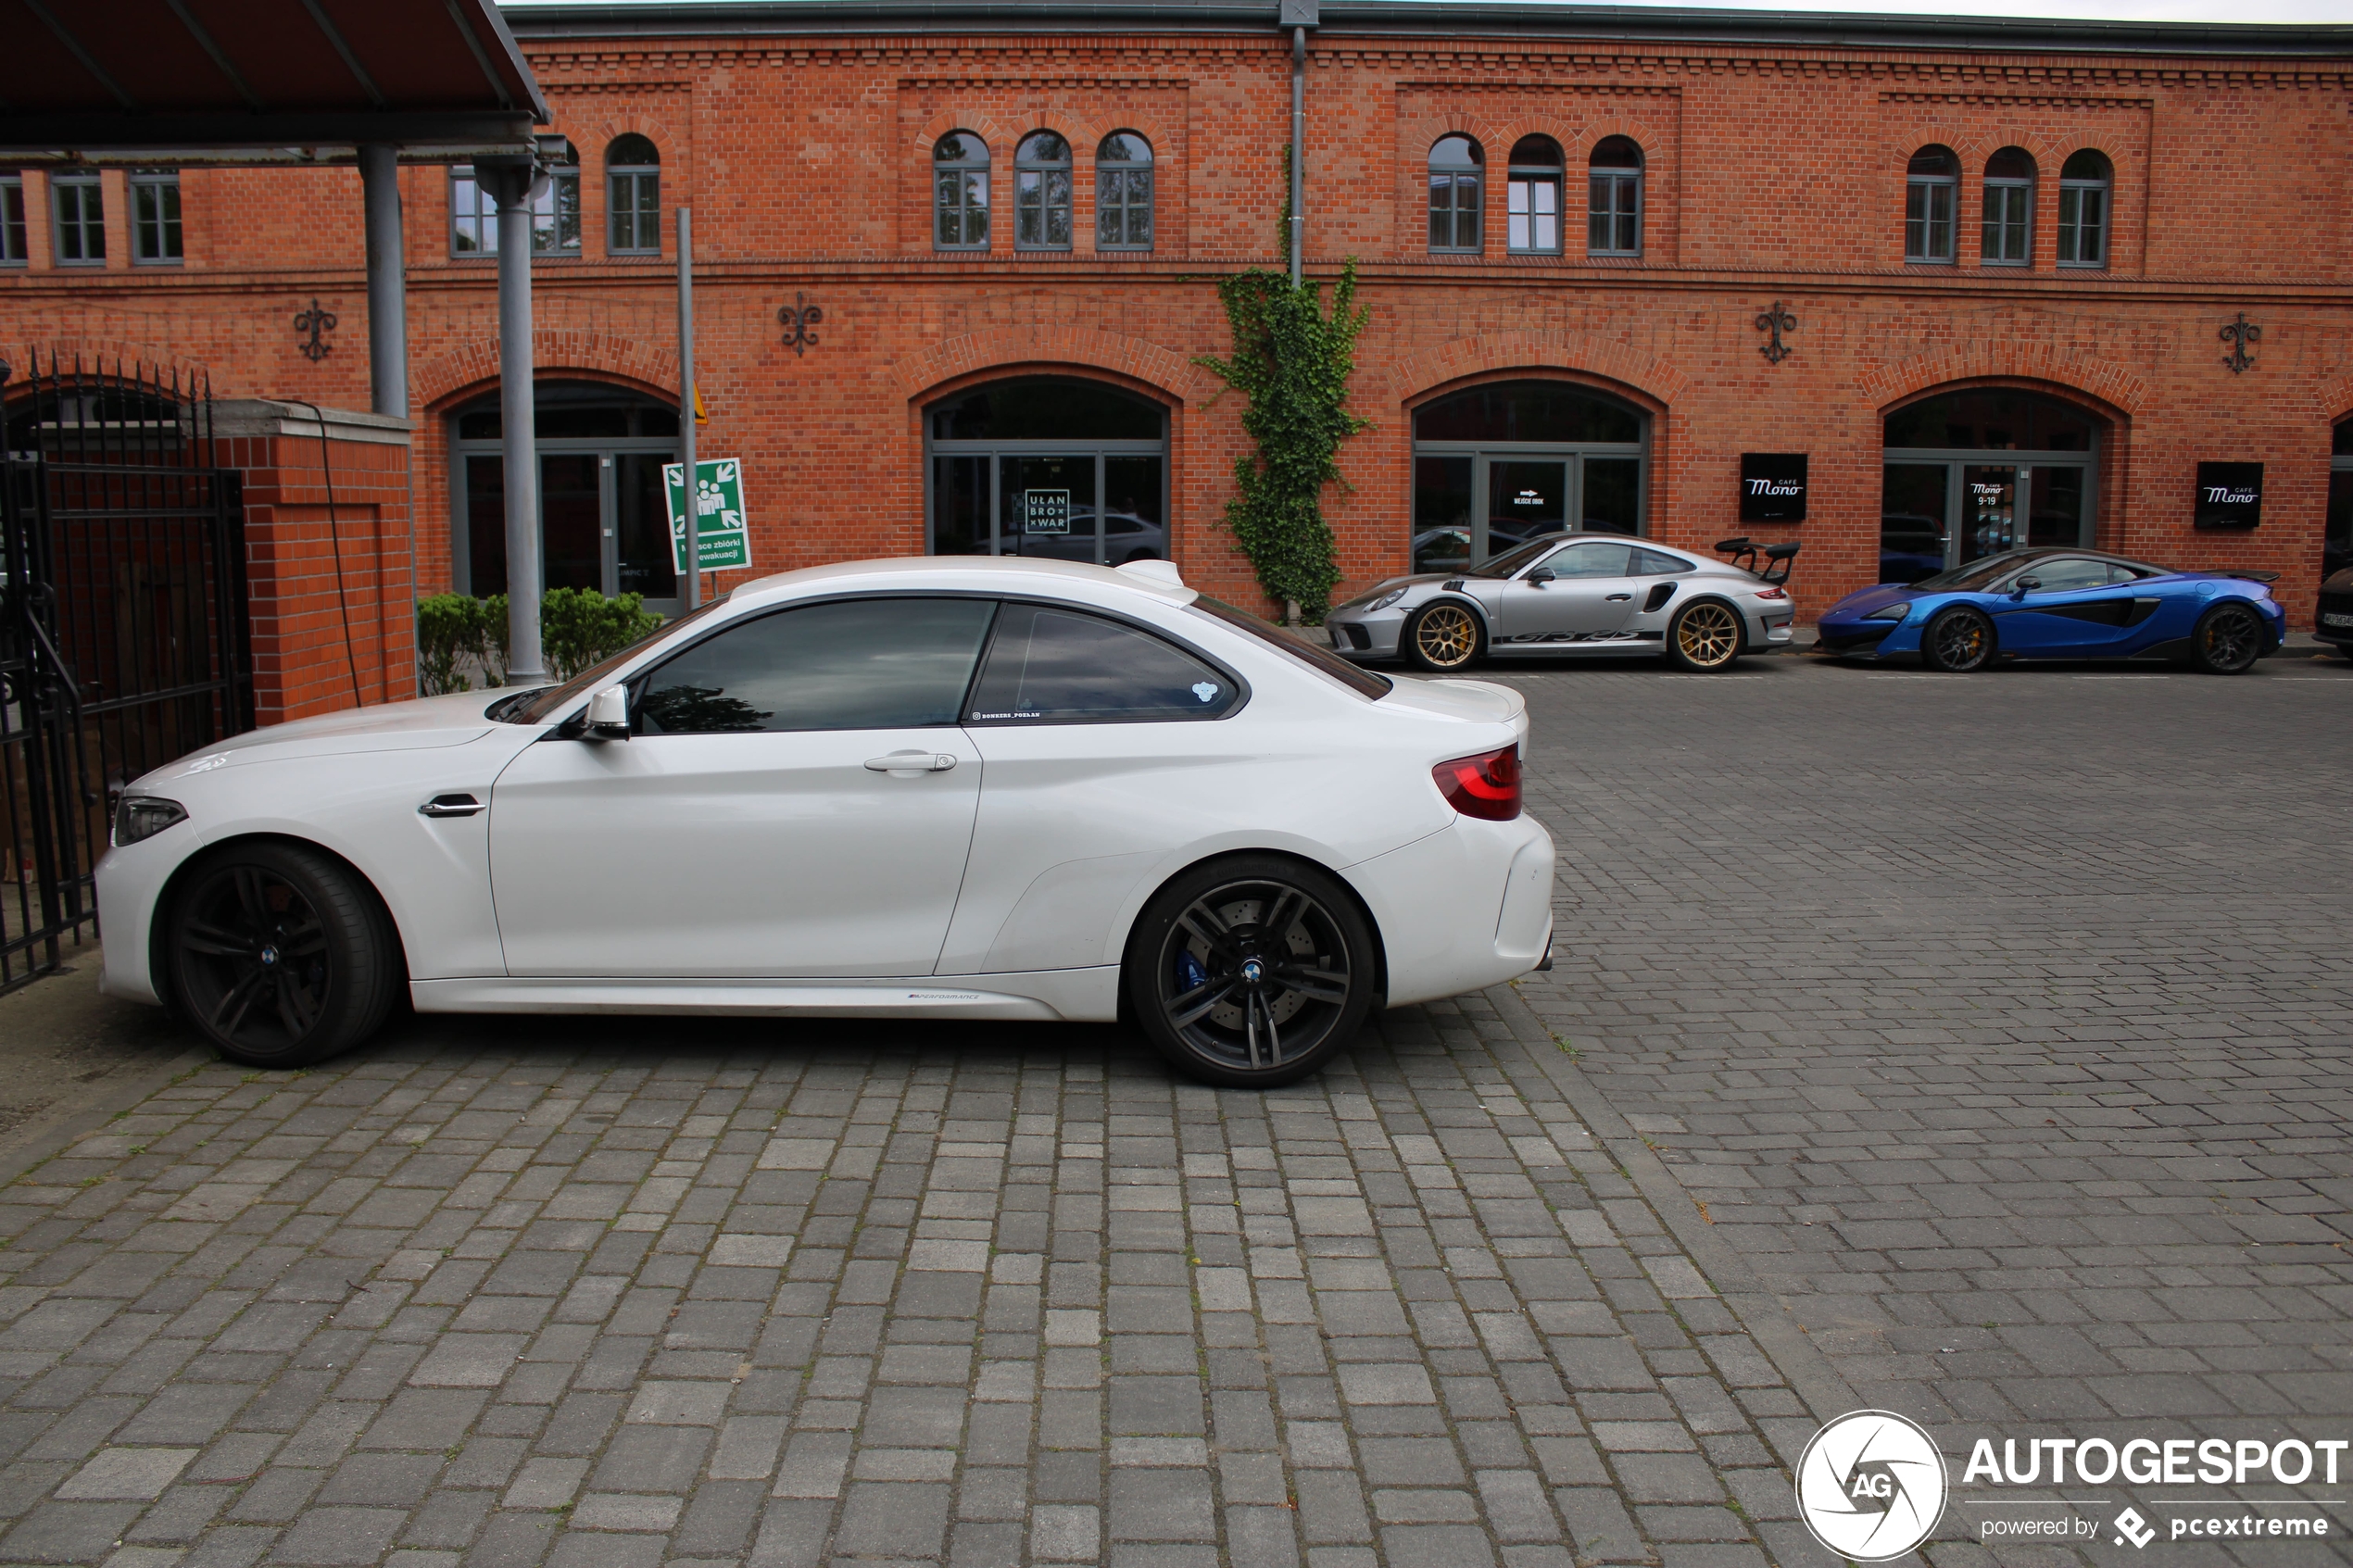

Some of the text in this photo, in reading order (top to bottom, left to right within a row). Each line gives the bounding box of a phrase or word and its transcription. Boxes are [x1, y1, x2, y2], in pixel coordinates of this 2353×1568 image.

[1745, 479, 1804, 495] Mono
[1970, 483, 2004, 494] Mono
[1030, 496, 1065, 505] UŁAN
[1978, 496, 1996, 505] 9-19
[2203, 487, 2259, 503] Mono
[713, 539, 741, 548] zbiórki
[698, 549, 738, 560] ewakuacji
[1510, 628, 1644, 642] GT3 RS
